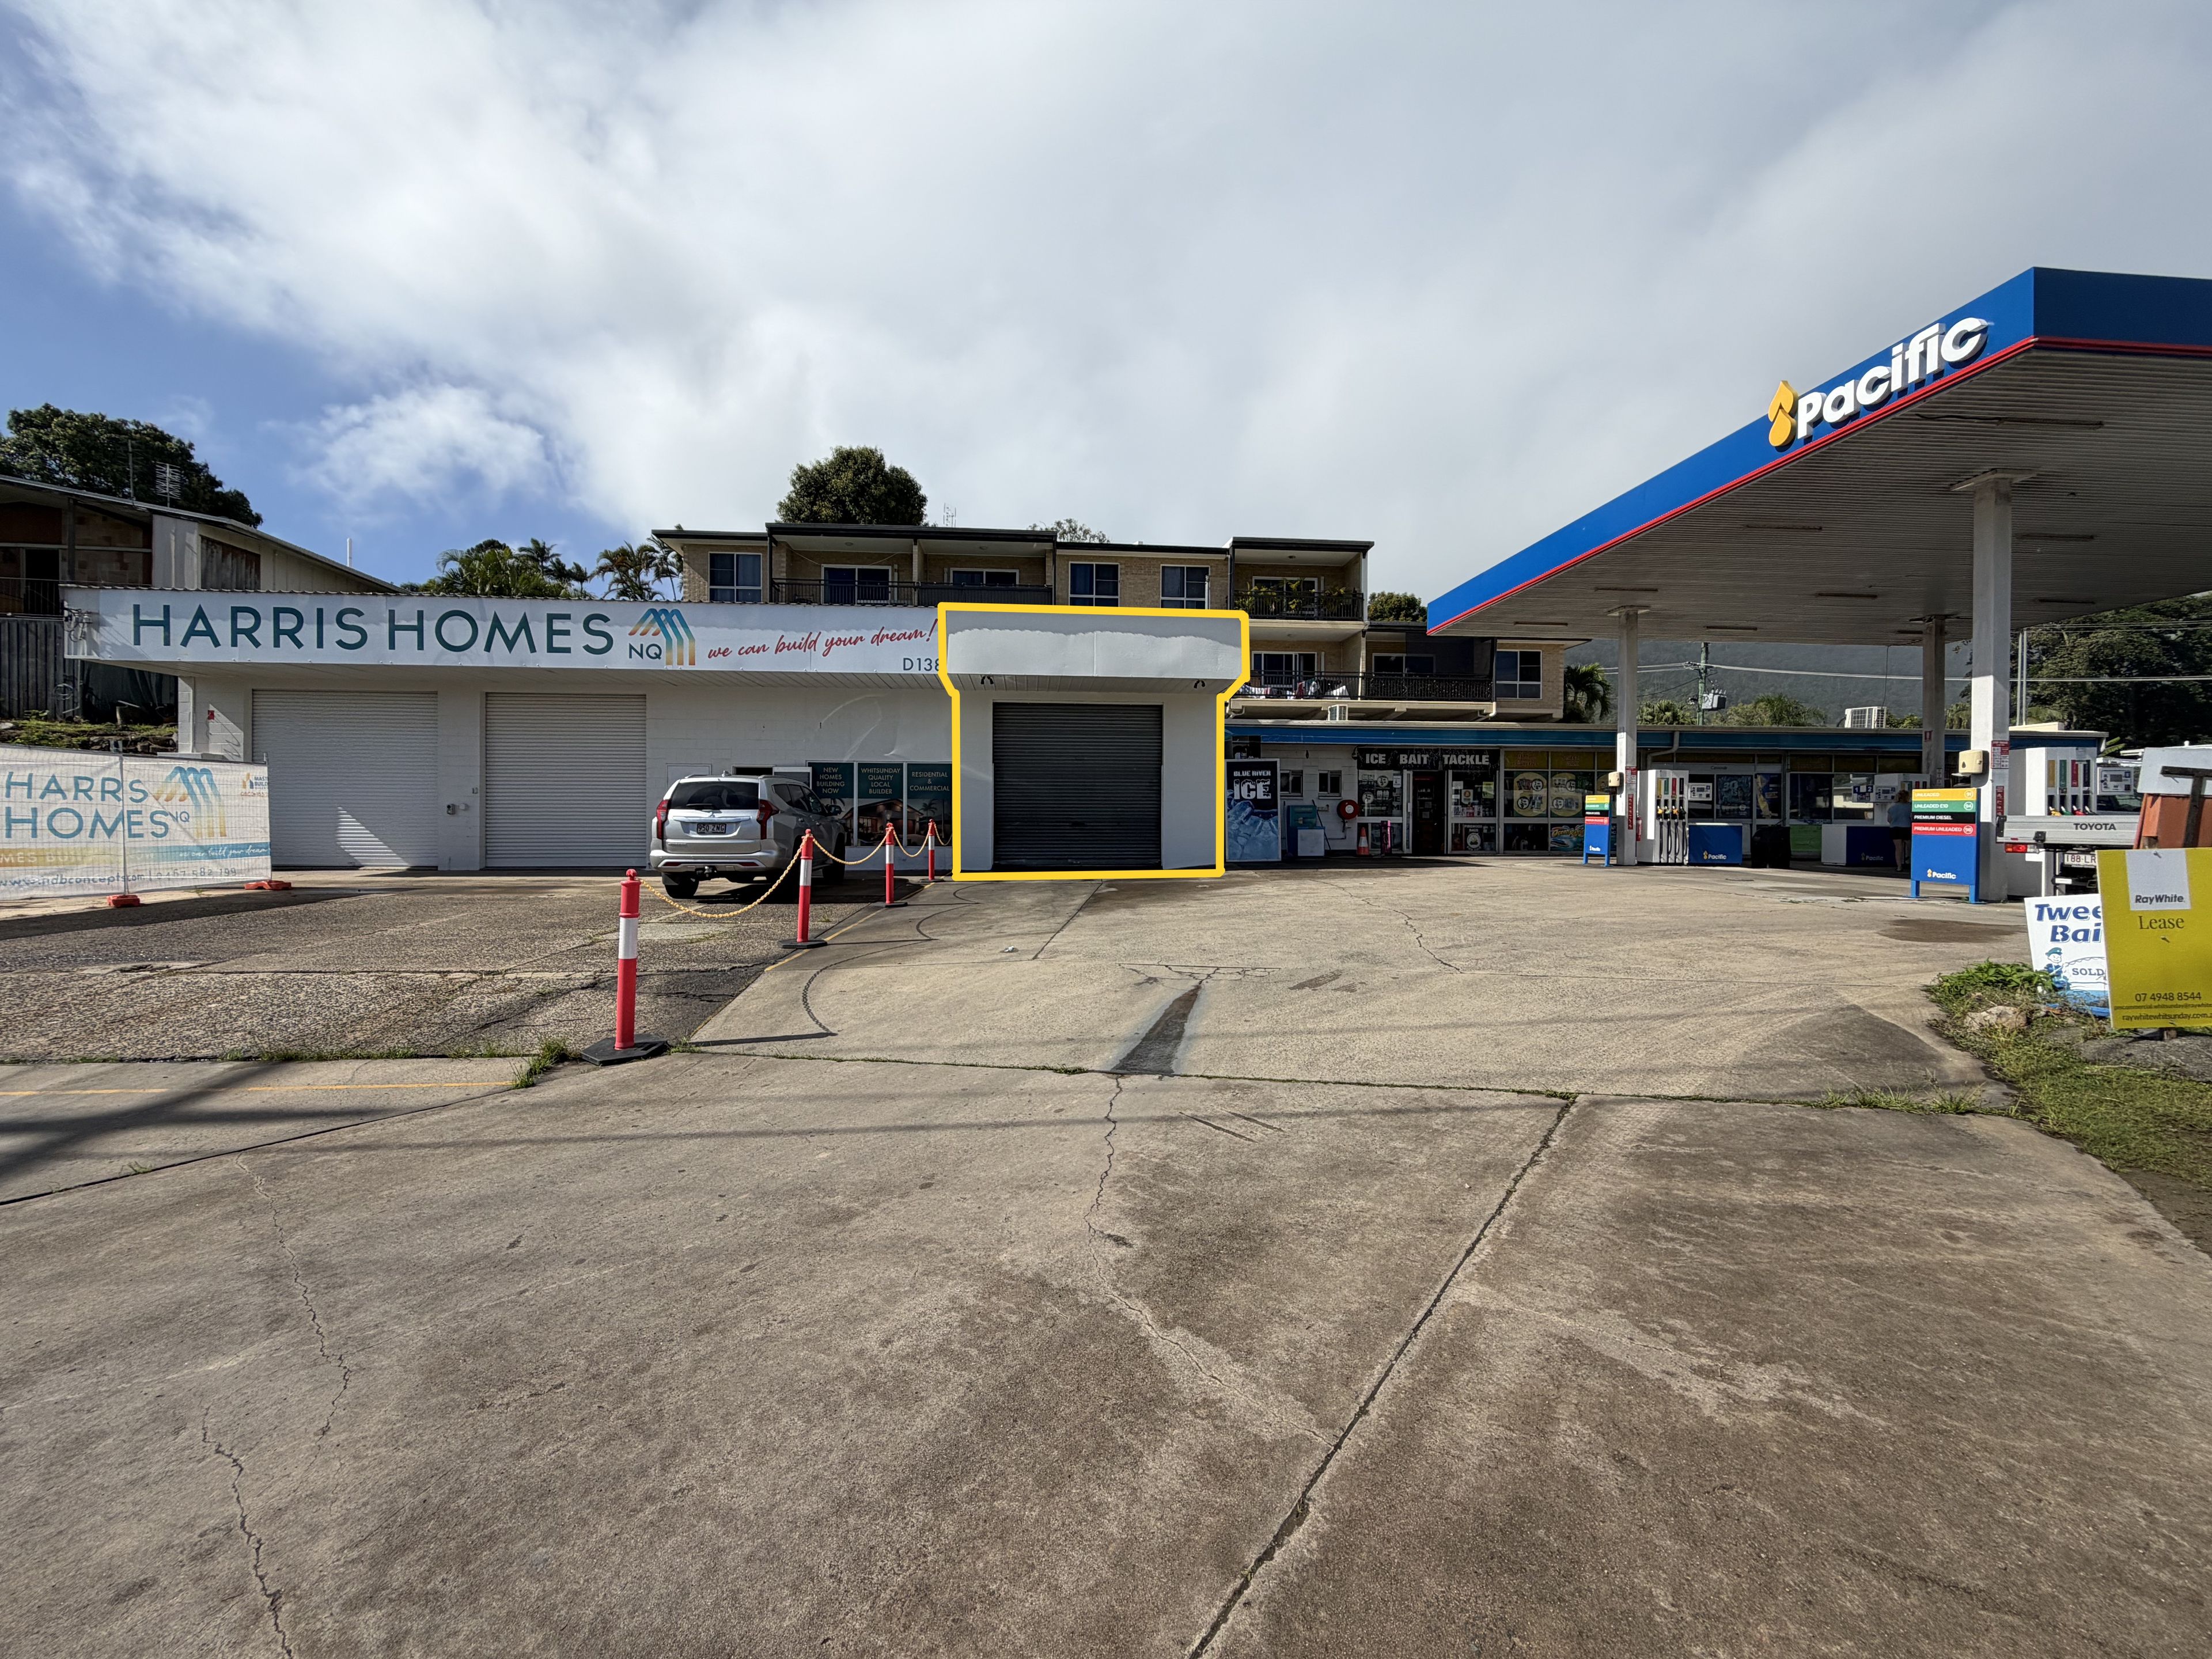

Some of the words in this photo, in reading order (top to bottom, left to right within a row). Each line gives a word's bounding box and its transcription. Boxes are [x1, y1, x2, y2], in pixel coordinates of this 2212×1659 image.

[1797, 317, 1988, 439] Pacific
[133, 604, 368, 650] HARRIS
[388, 609, 613, 655] HOMES
[707, 646, 732, 660] we
[737, 643, 770, 657] can
[774, 631, 818, 655] build
[822, 634, 865, 657] your
[870, 618, 938, 646] dream!
[628, 642, 662, 661] NQ
[1365, 753, 1387, 764] ICE
[1399, 753, 1430, 765] BAIT
[1442, 754, 1490, 765] TACKLE
[5, 771, 149, 804] HARRS
[1234, 779, 1271, 800] ICE
[5, 806, 170, 839] HOMES
[220, 868, 237, 877] 199
[1933, 872, 1957, 880] Pacific
[2050, 922, 2102, 943] Bai
[2138, 915, 2185, 930] Lease
[2072, 968, 2104, 976] SOLD
[2135, 993, 2147, 1002] 07
[2150, 993, 2175, 1002] 4948
[2177, 993, 2202, 1001] 8544
